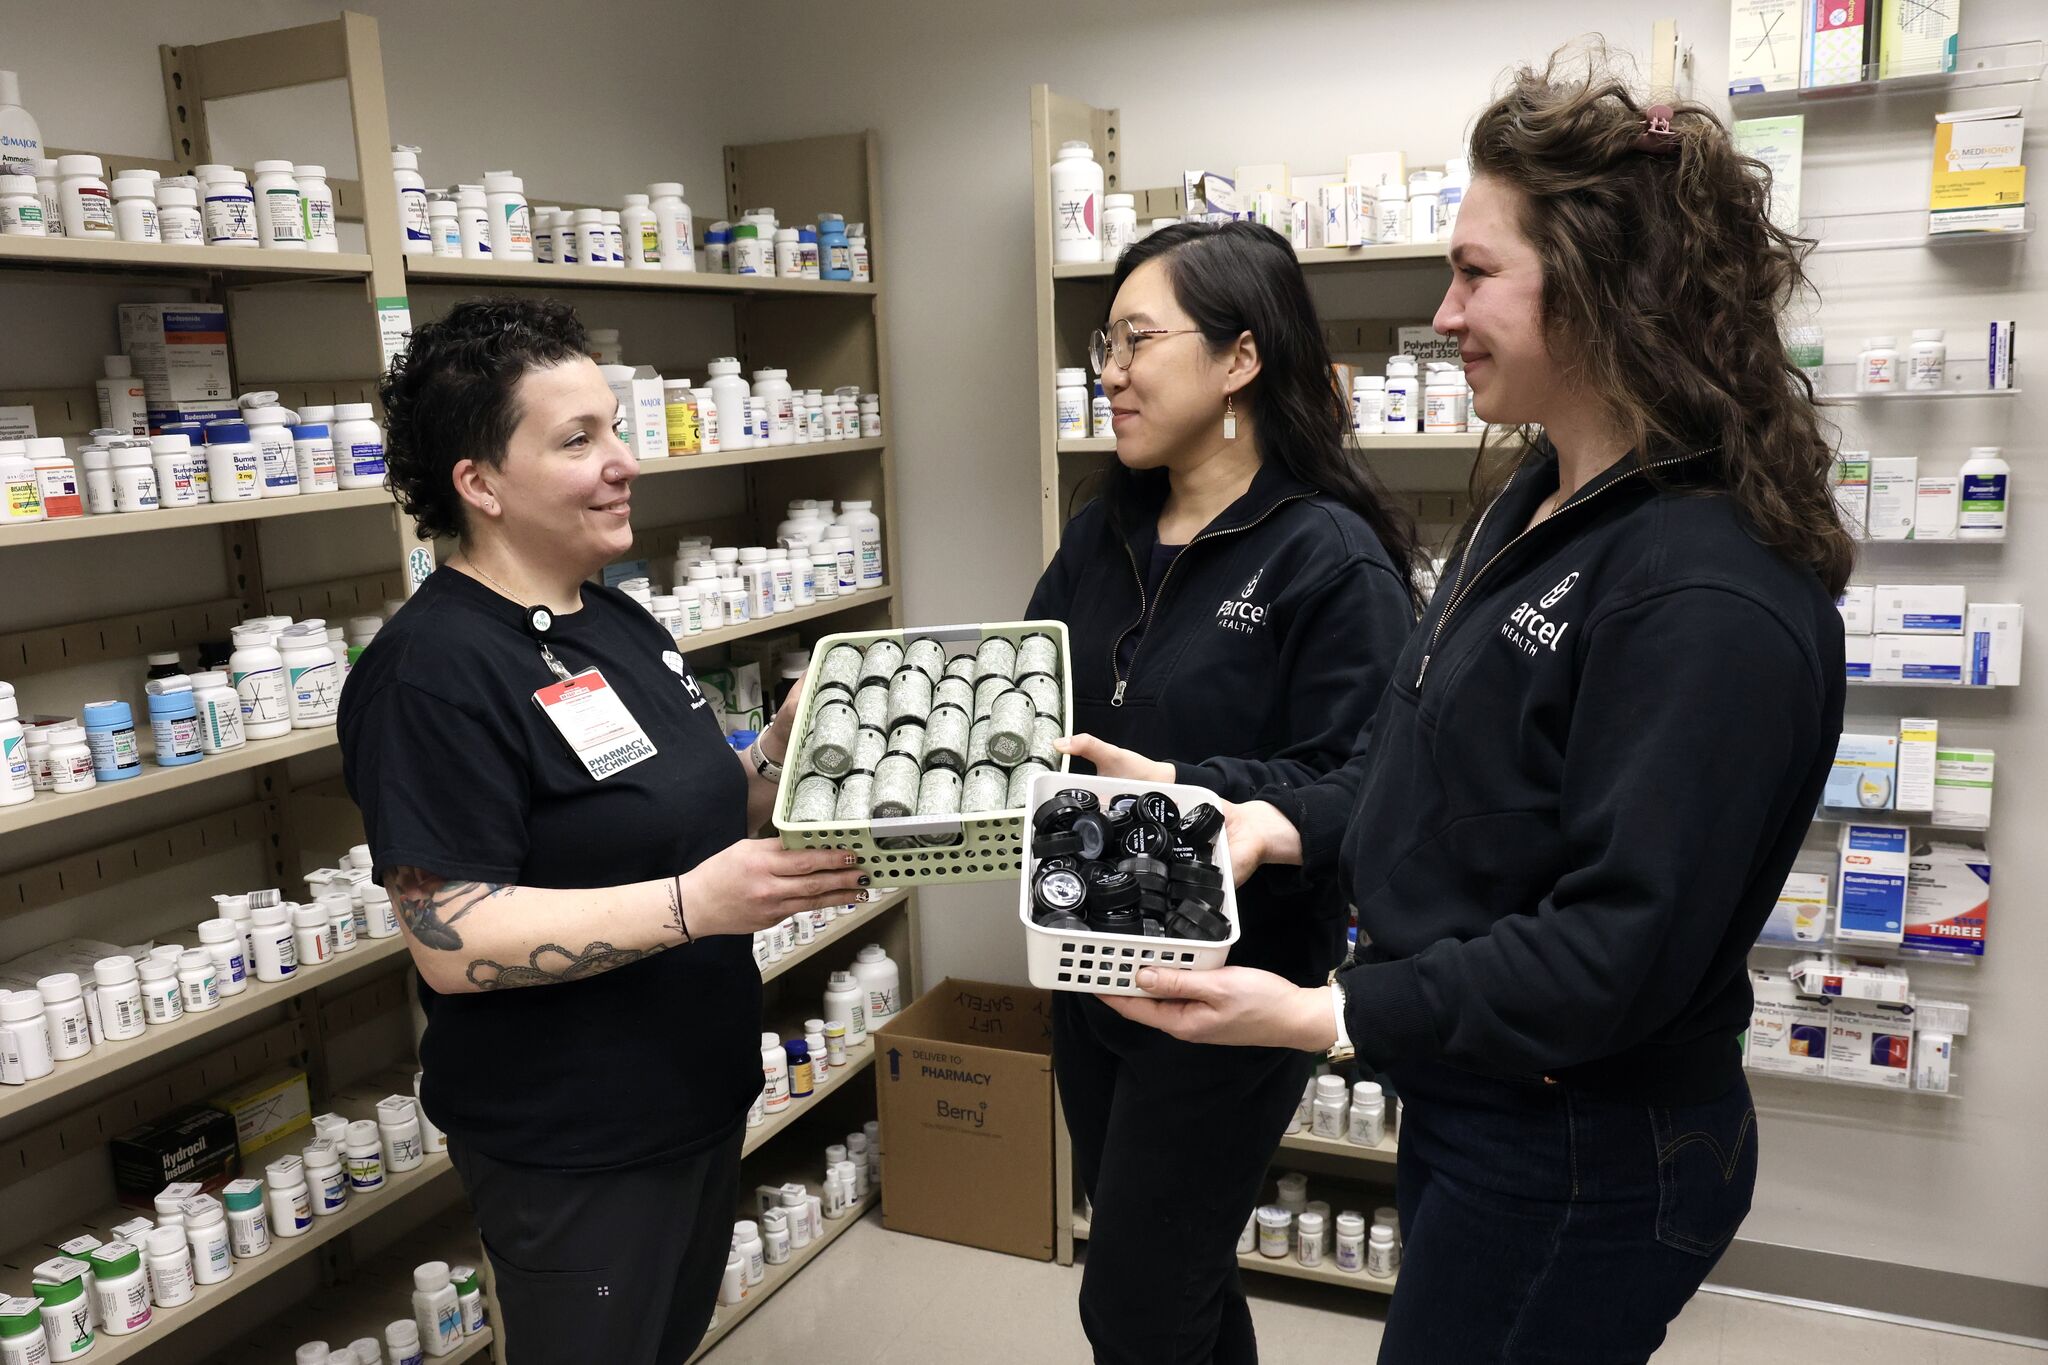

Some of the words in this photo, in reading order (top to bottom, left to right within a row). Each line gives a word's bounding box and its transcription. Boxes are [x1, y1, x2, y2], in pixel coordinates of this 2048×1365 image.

[10, 137, 37, 149] MAJOR
[1961, 145, 2016, 156] MEDIHONEY
[640, 398, 662, 407] MAJOR
[1510, 602, 1569, 652] arcel
[1500, 623, 1539, 657] HEALTH
[587, 737, 645, 769] PHARMACY
[590, 744, 653, 778] TECHNICIAN
[1929, 924, 1982, 938] THREE
[953, 991, 1016, 1012] SAFELY
[968, 1016, 1003, 1033] LIFT
[1833, 1027, 1843, 1036] 21
[1845, 1030, 1862, 1040] mg
[912, 1050, 947, 1063] DELIVER
[949, 1056, 962, 1065] TO
[921, 1065, 992, 1086] PHARMACY
[936, 1099, 984, 1128] Berry
[162, 1136, 207, 1169] Hydrocil
[164, 1159, 195, 1181] Instant
